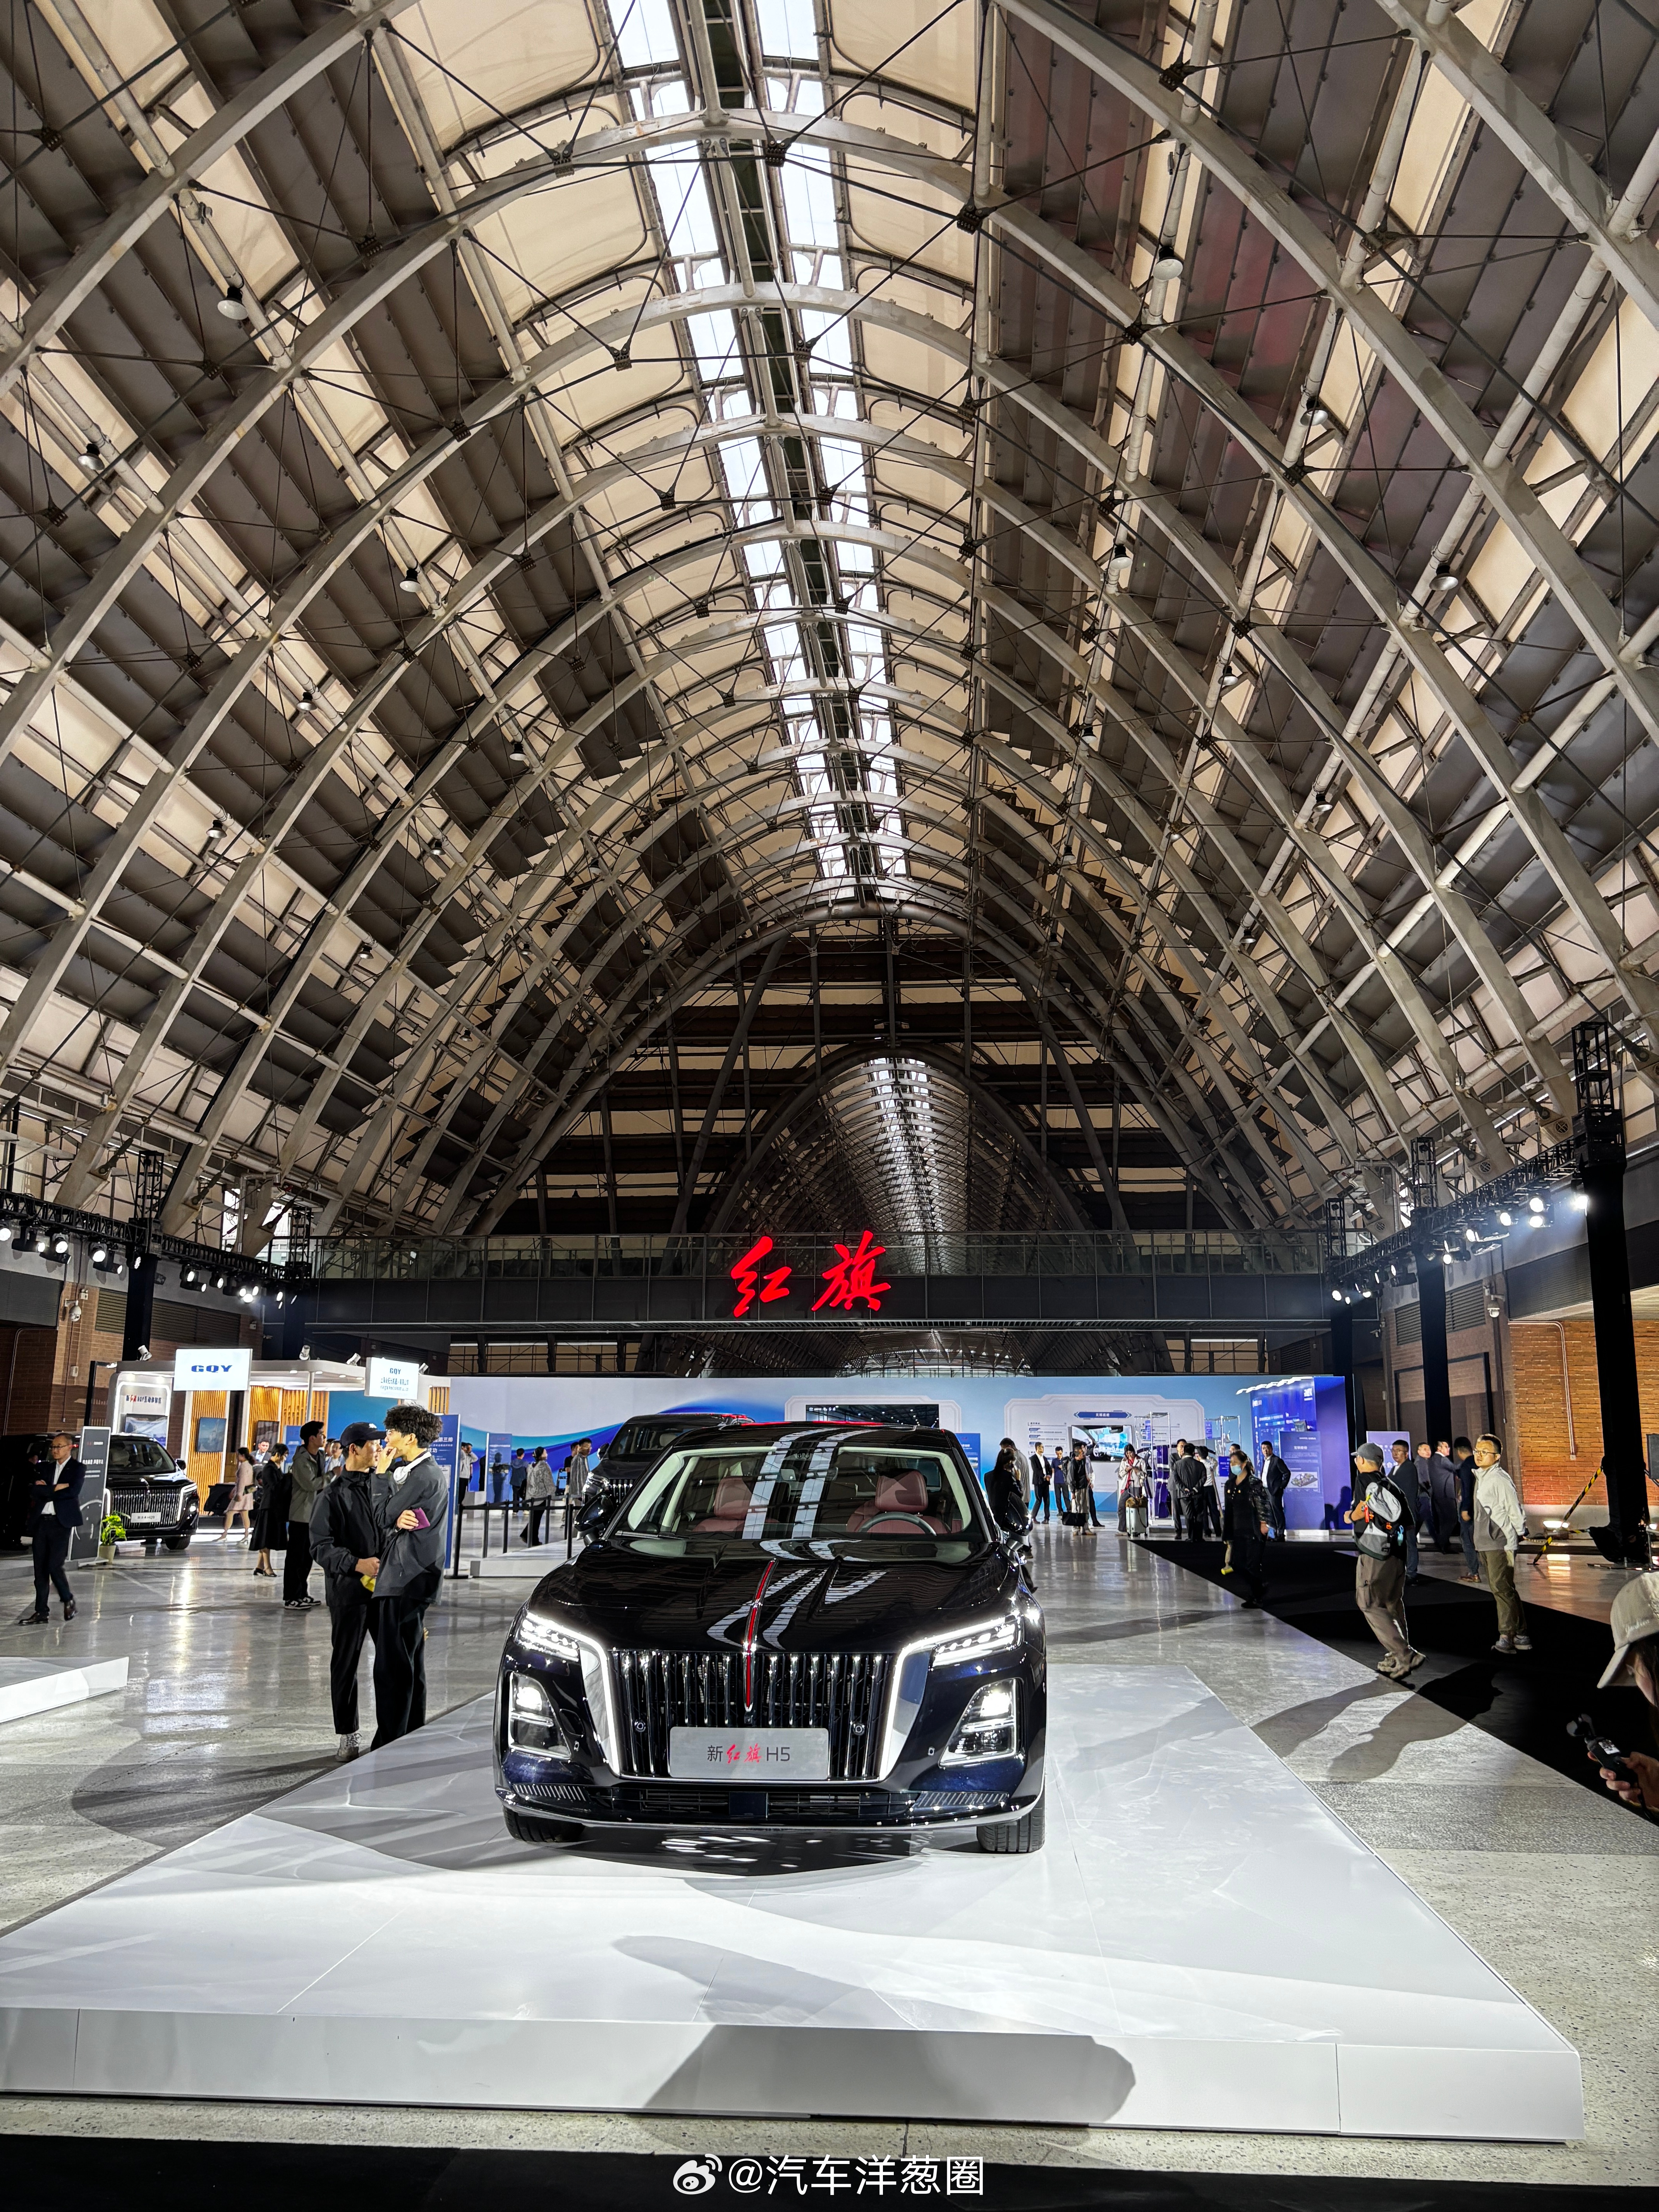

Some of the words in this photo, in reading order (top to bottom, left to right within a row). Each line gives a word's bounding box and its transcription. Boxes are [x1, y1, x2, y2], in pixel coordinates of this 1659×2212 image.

[730, 1230, 891, 1317] 红旗
[707, 1743, 790, 1764] 新红旗H5
